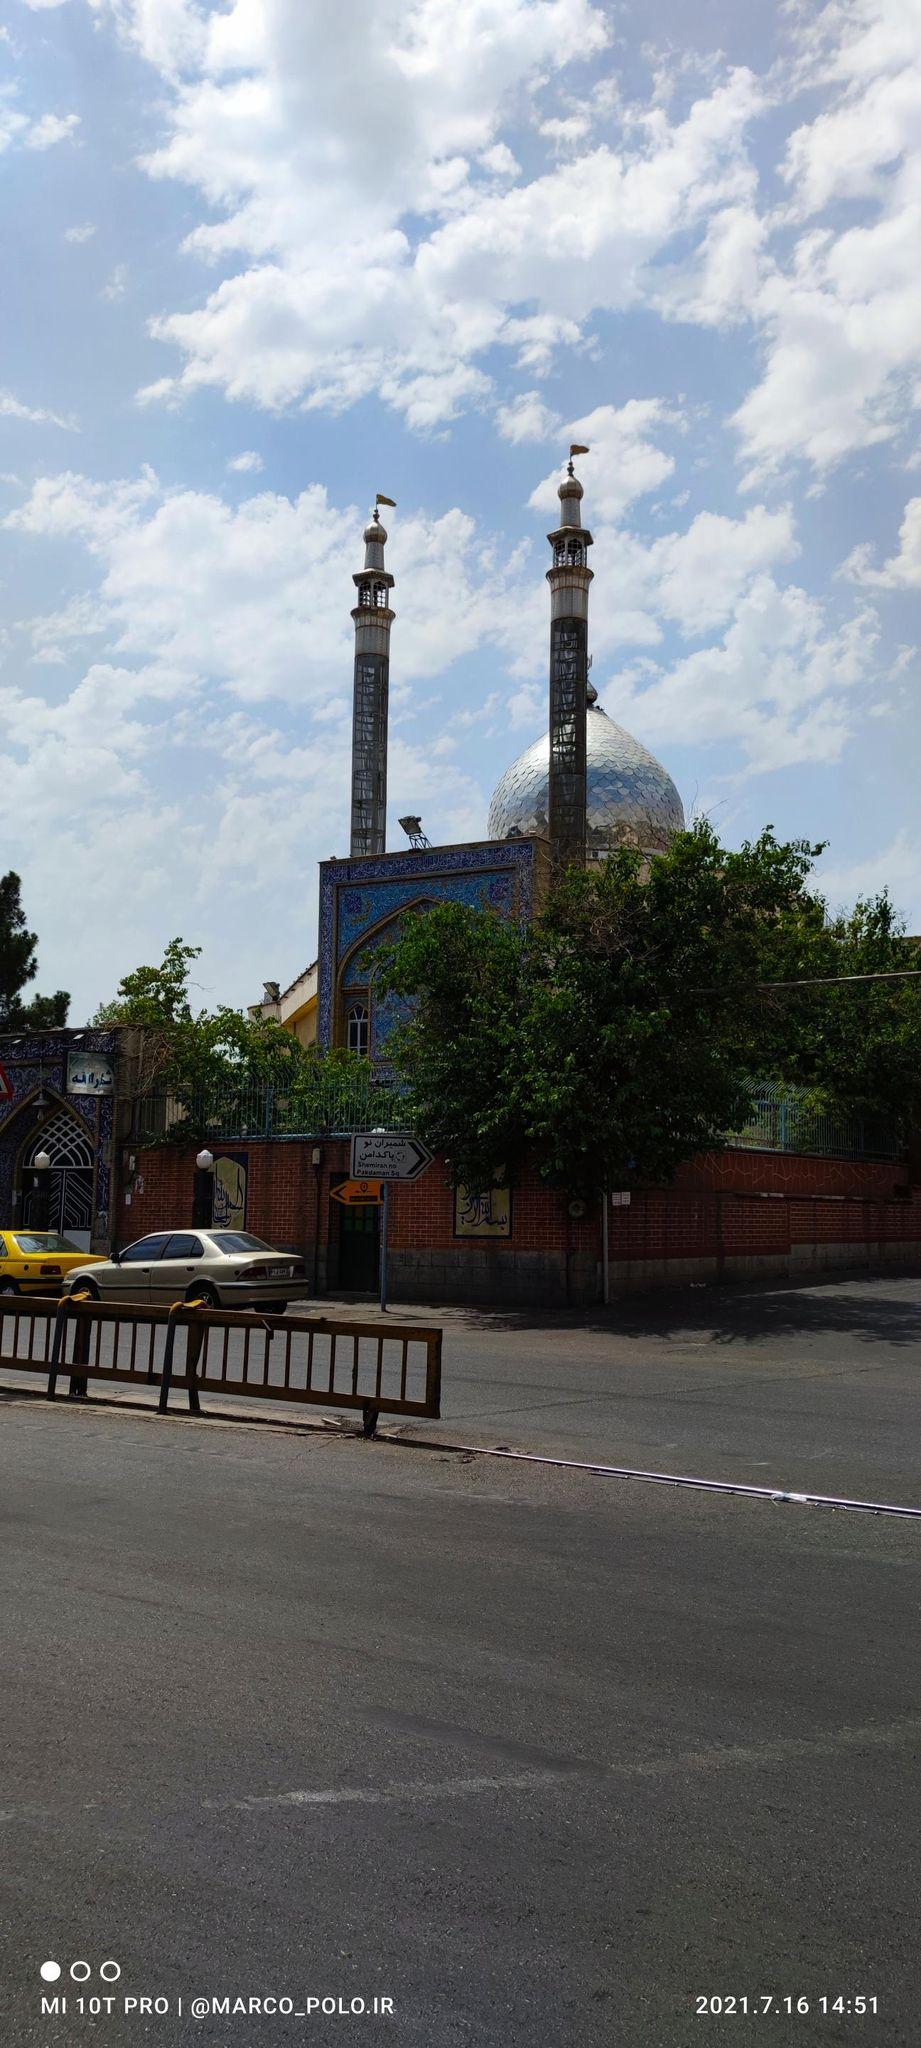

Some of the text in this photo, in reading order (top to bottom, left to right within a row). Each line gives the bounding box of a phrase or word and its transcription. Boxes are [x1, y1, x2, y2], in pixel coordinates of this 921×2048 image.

[363, 1139, 406, 1149] شمیران نو
[360, 1151, 396, 1162] پاکدامن
